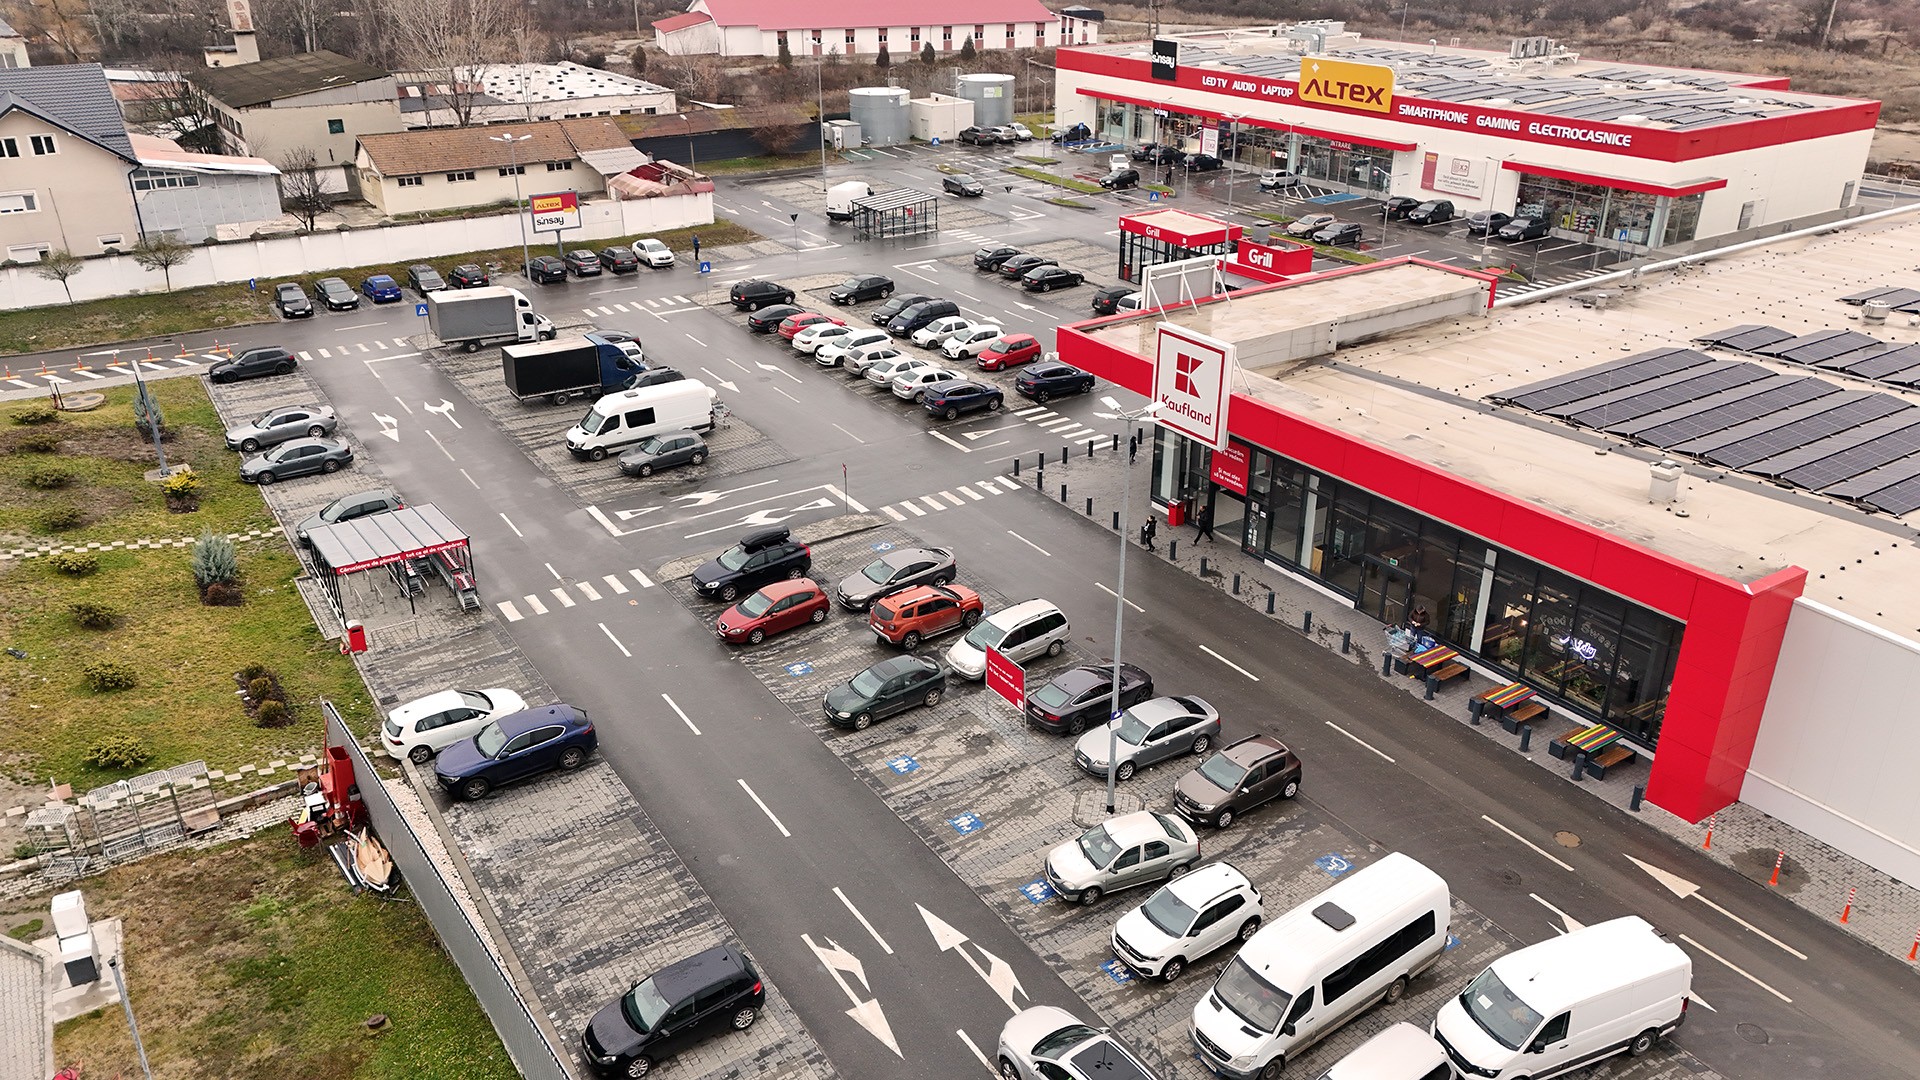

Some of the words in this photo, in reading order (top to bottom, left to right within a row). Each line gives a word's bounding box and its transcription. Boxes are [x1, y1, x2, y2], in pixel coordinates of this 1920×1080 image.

[1152, 53, 1175, 68] sinsay
[1202, 75, 1216, 86] LED
[1216, 78, 1228, 88] TV
[1231, 81, 1257, 92] AUDIO
[1261, 84, 1294, 98] LAPTOP
[1303, 78, 1385, 106] ALTEX
[1398, 104, 1469, 125] SMARTPHONE
[1475, 115, 1521, 132] GAMING
[1528, 122, 1632, 147] ELECTROCASNICE
[536, 216, 565, 226] sinsay
[1145, 226, 1160, 238] Grill
[1248, 248, 1273, 268] Grill
[1161, 393, 1212, 426] Kaufland
